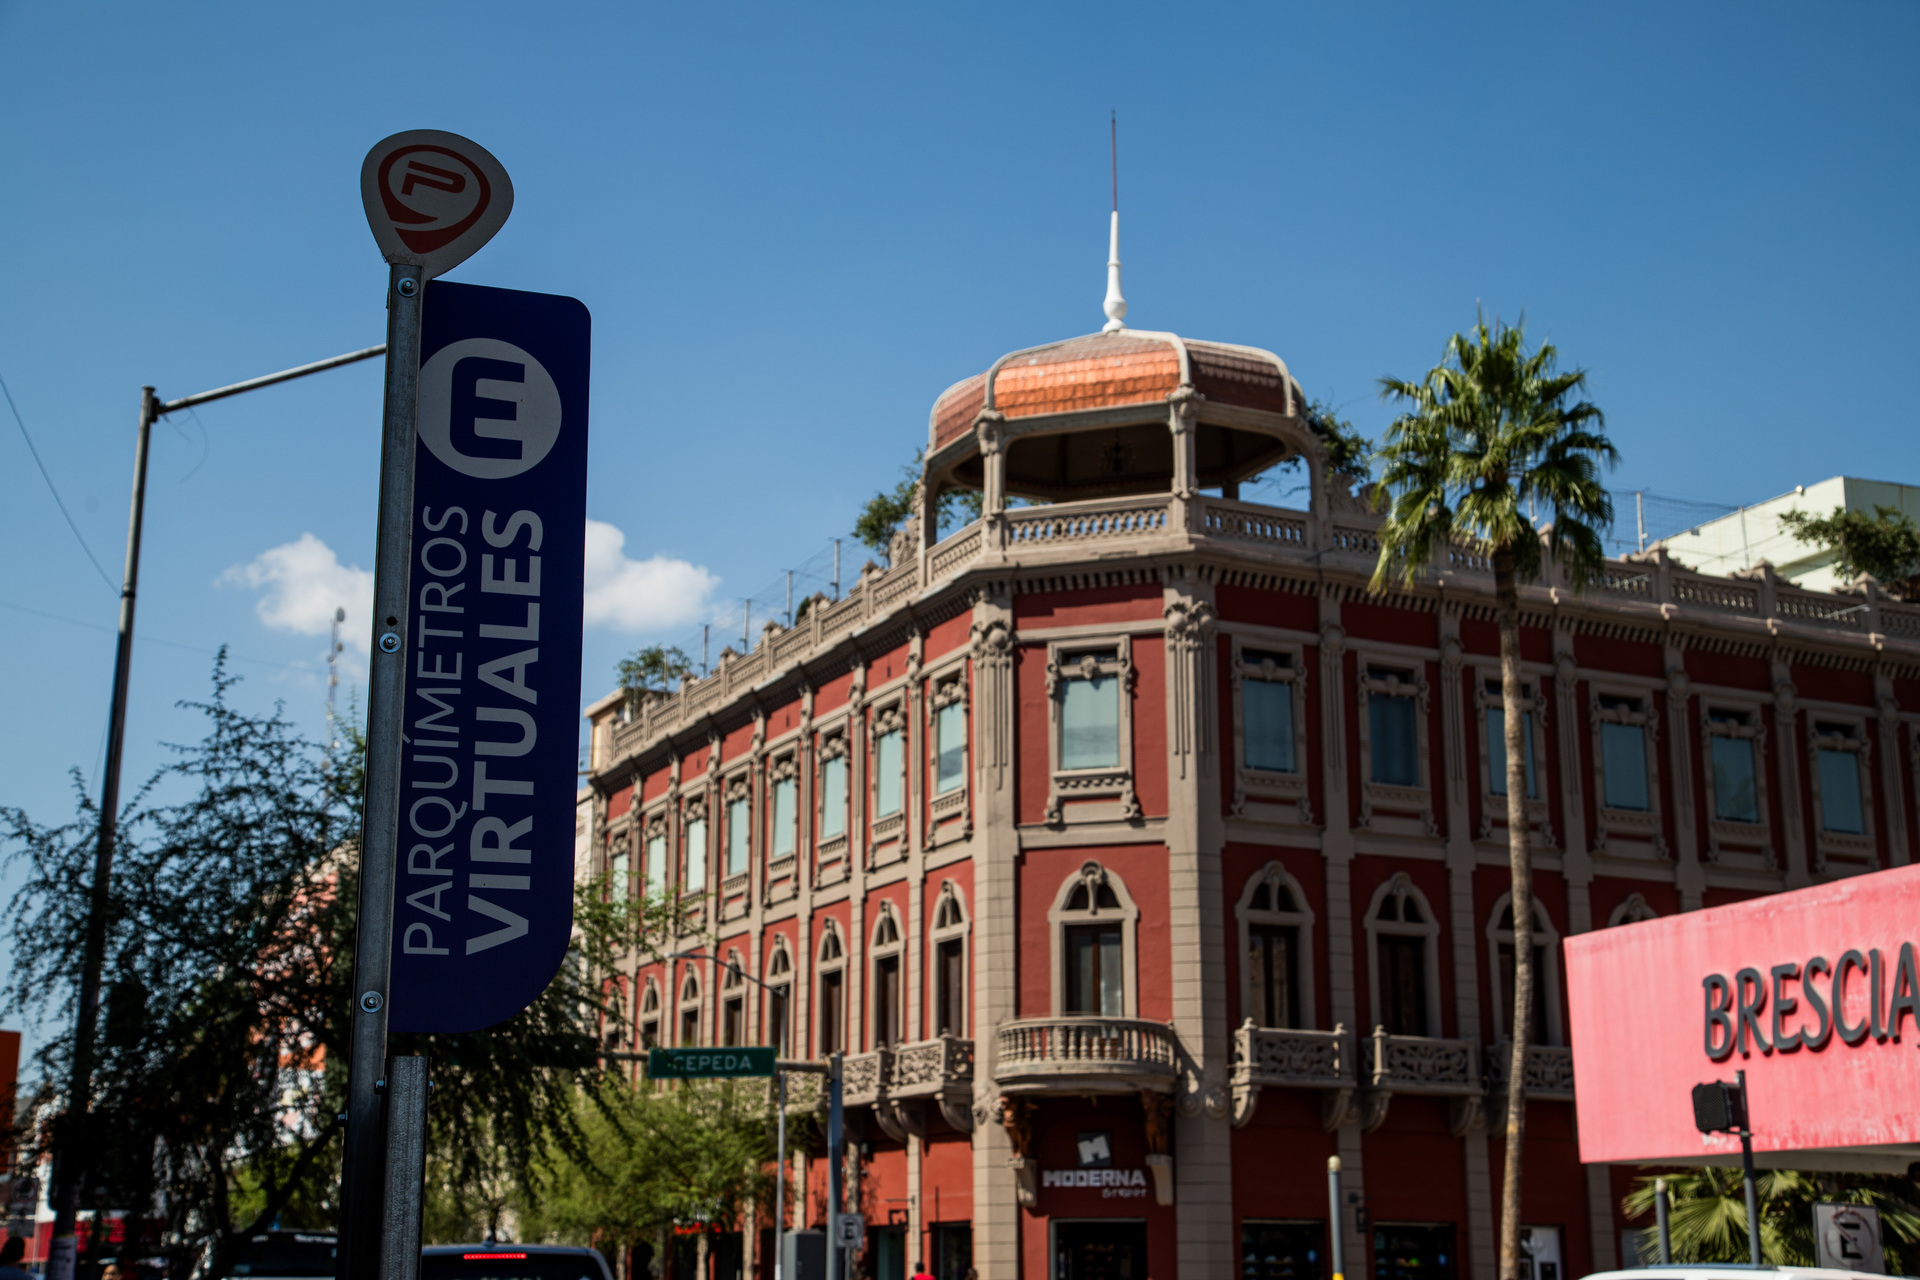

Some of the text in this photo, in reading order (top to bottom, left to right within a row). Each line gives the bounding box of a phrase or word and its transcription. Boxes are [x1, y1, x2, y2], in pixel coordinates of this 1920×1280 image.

[403, 505, 468, 956] PARQUÍMETROS
[466, 509, 543, 956] VIRTUALES
[1702, 941, 1920, 1060] BRESCIA
[1042, 1169, 1147, 1187] MODERNA
